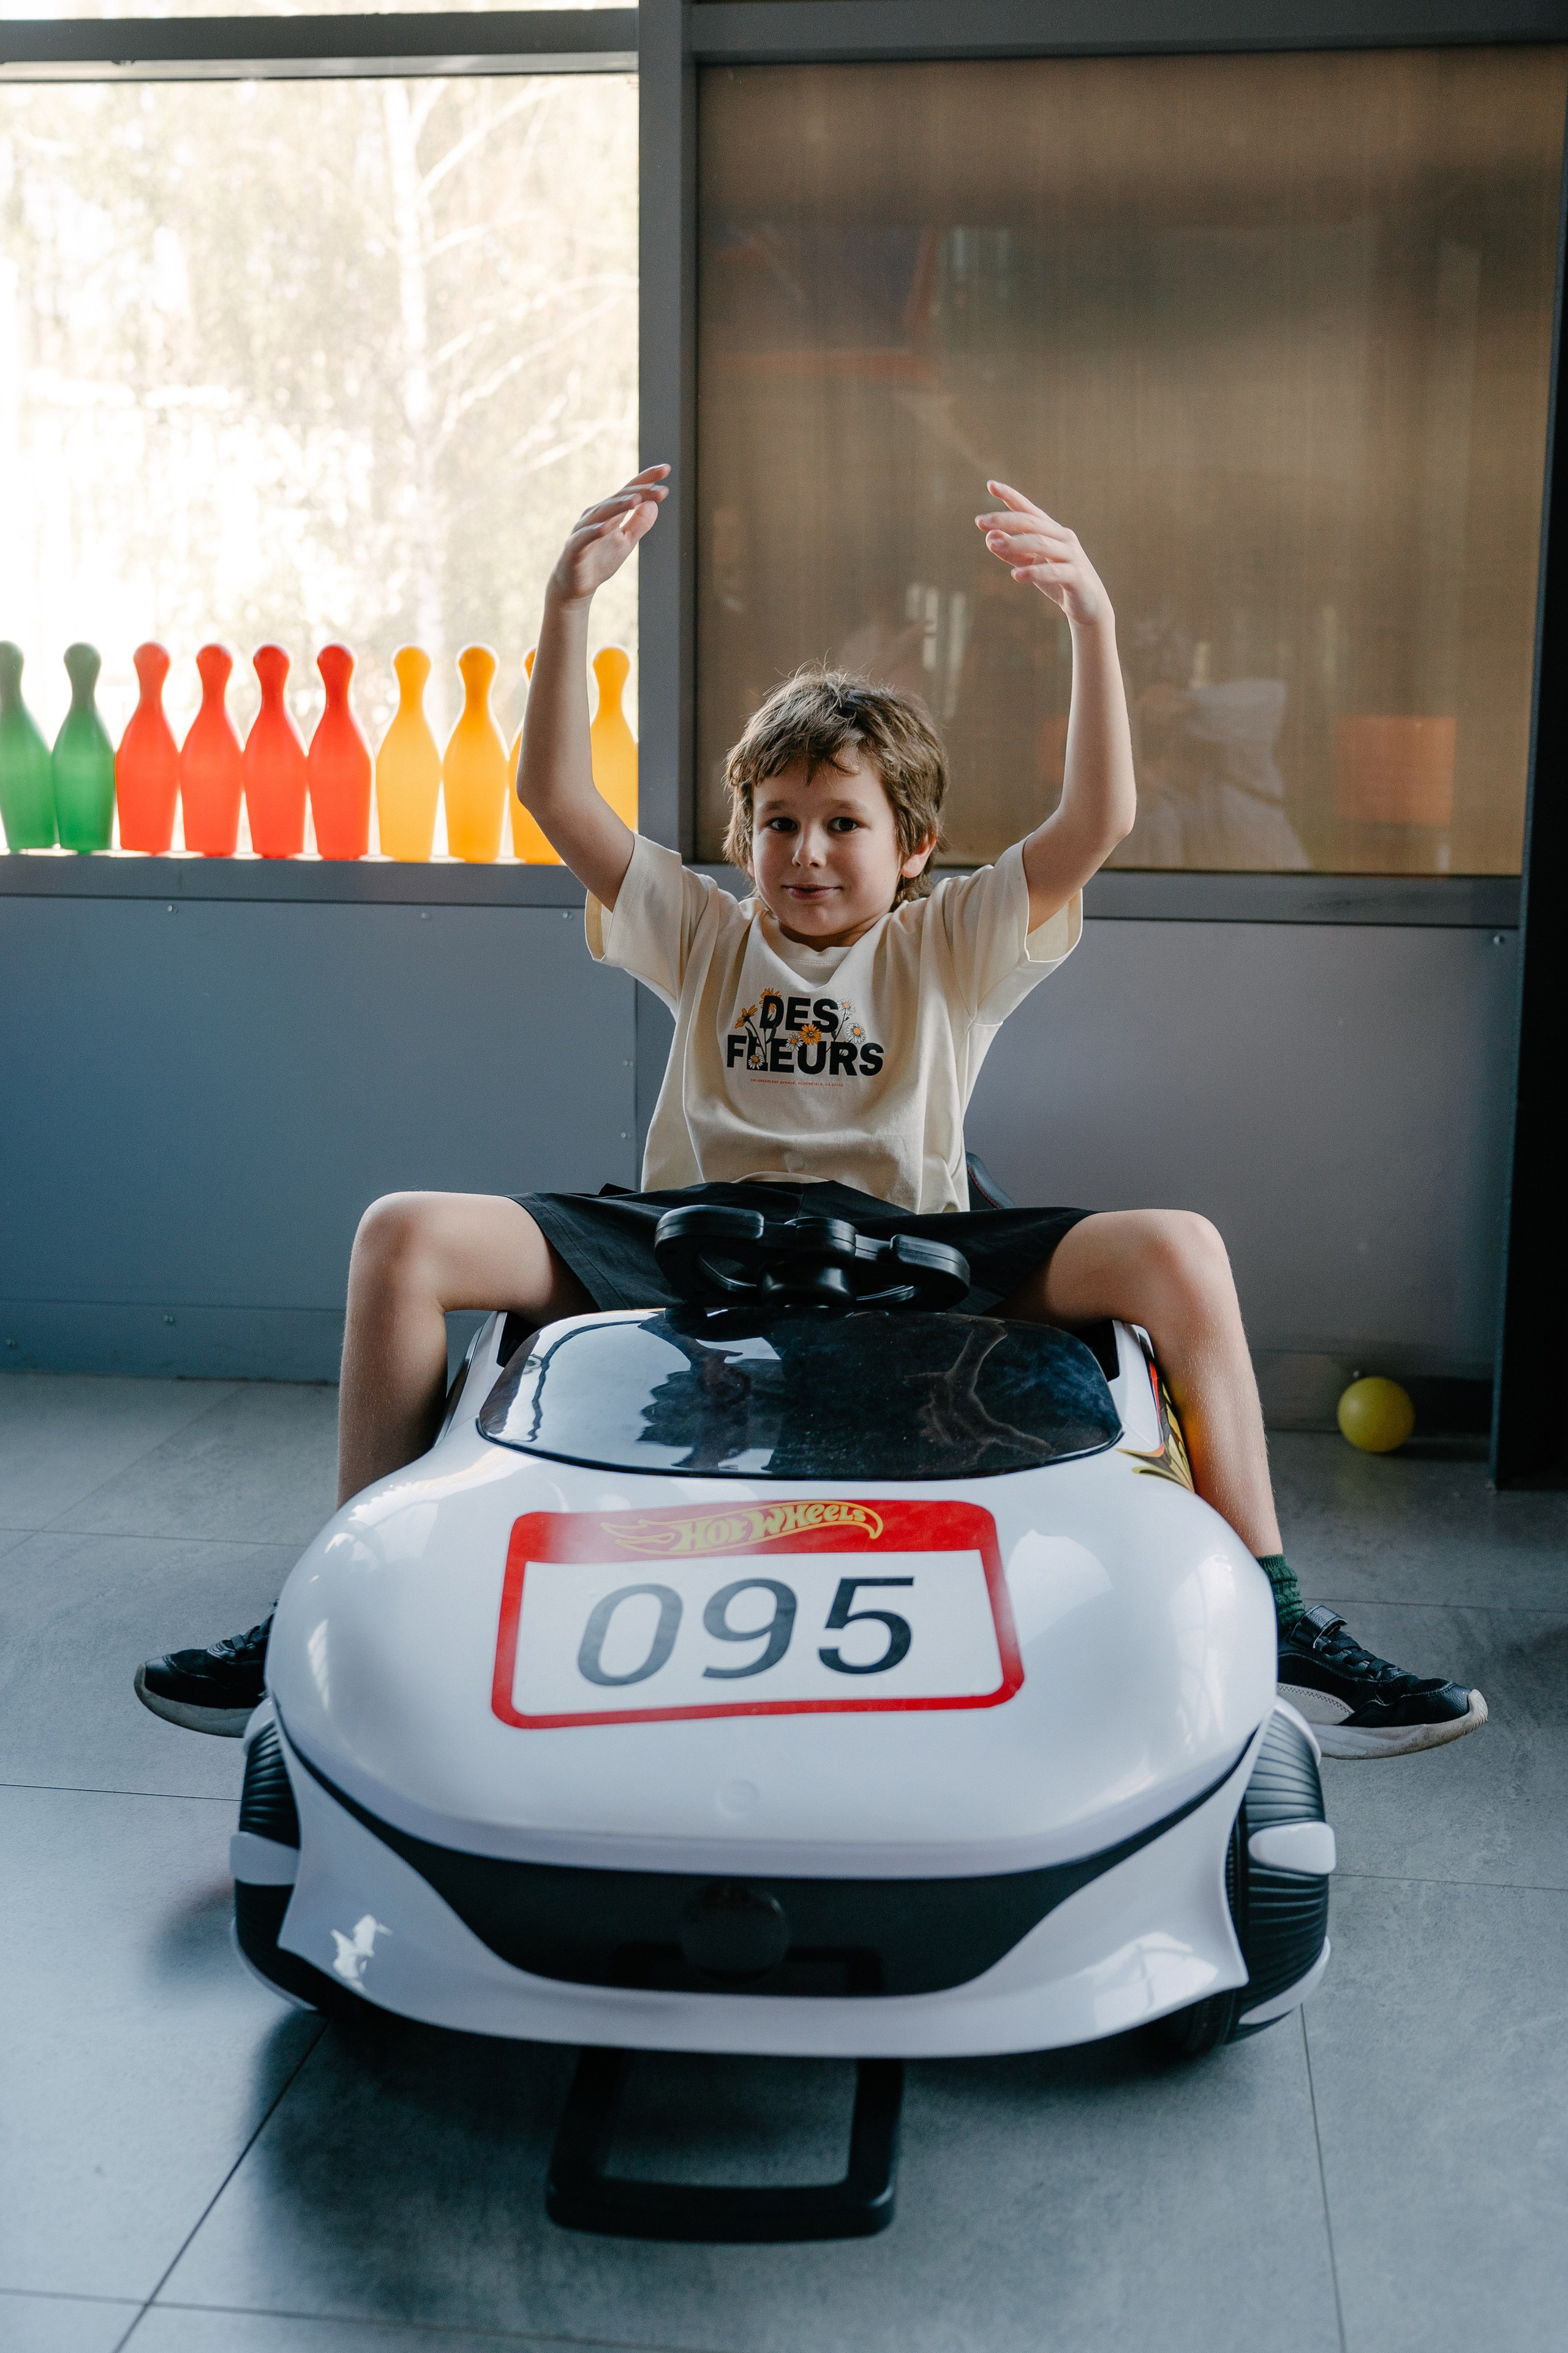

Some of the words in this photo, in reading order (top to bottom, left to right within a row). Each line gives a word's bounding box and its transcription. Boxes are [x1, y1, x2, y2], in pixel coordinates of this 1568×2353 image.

[760, 995, 839, 1033] DES
[726, 1034, 884, 1077] FLEURS
[577, 1576, 915, 1687] 095
